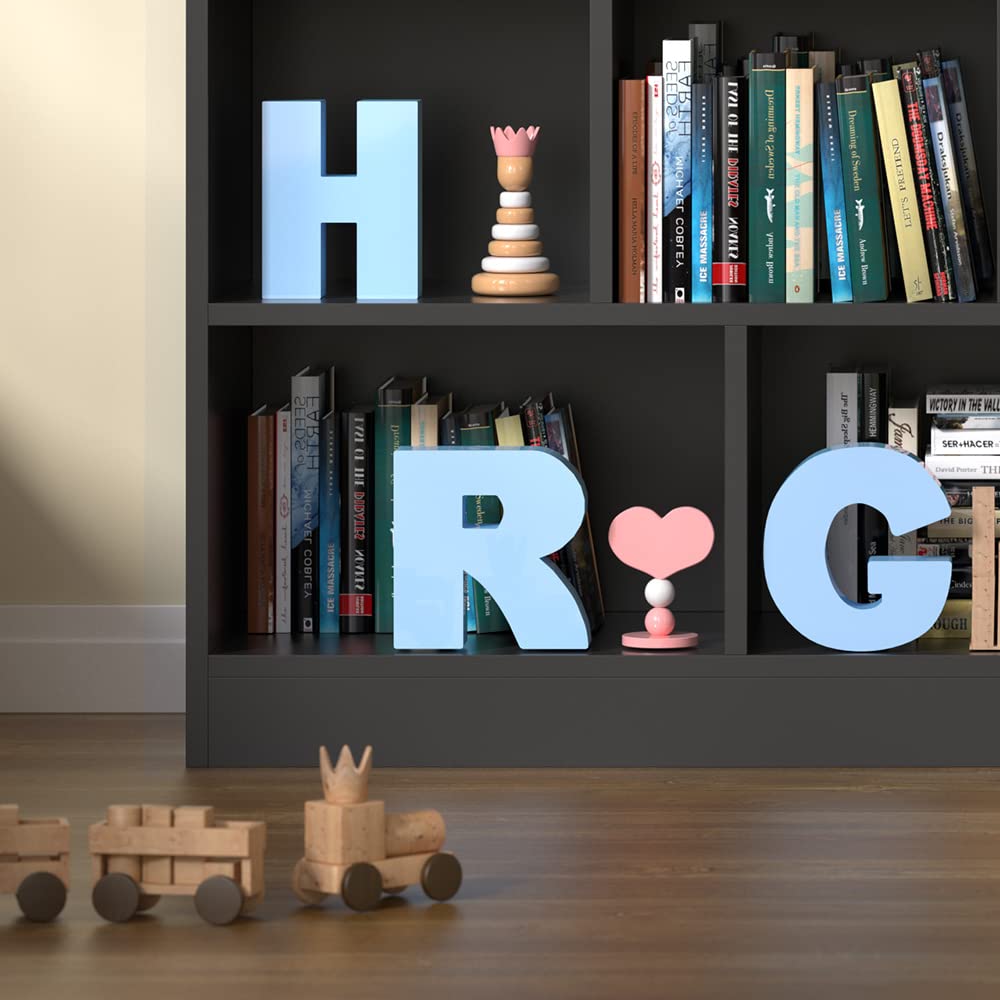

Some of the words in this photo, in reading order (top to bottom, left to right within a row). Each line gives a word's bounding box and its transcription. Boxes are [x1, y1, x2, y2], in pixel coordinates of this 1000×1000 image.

[847, 110, 859, 148] Dreaming
[907, 102, 919, 123] THE
[891, 138, 907, 192] PRETEND
[911, 124, 929, 181] DOOMSDAY
[938, 131, 954, 200] Draksjukan
[956, 113, 971, 181] Draksjukan
[851, 160, 862, 192] Sweden
[261, 99, 421, 303] H
[900, 196, 913, 228] LET'S
[921, 184, 938, 231] MACHINE
[698, 210, 709, 264] MASSACRE
[833, 209, 847, 264] MASSACRE
[858, 238, 866, 263] Andrew
[698, 266, 709, 282] ICE
[837, 265, 848, 281] ICE
[860, 264, 869, 286] Brown
[869, 387, 877, 438] HEMMINGWAY
[929, 398, 958, 412] VICTORY
[958, 398, 966, 412] IN
[969, 398, 982, 412] THE
[935, 466, 955, 474] David
[956, 466, 977, 474] Porter
[327, 543, 335, 595] MASSACRE
[393, 447, 588, 649] R
[763, 443, 952, 652] G
[327, 597, 335, 612] ICE
